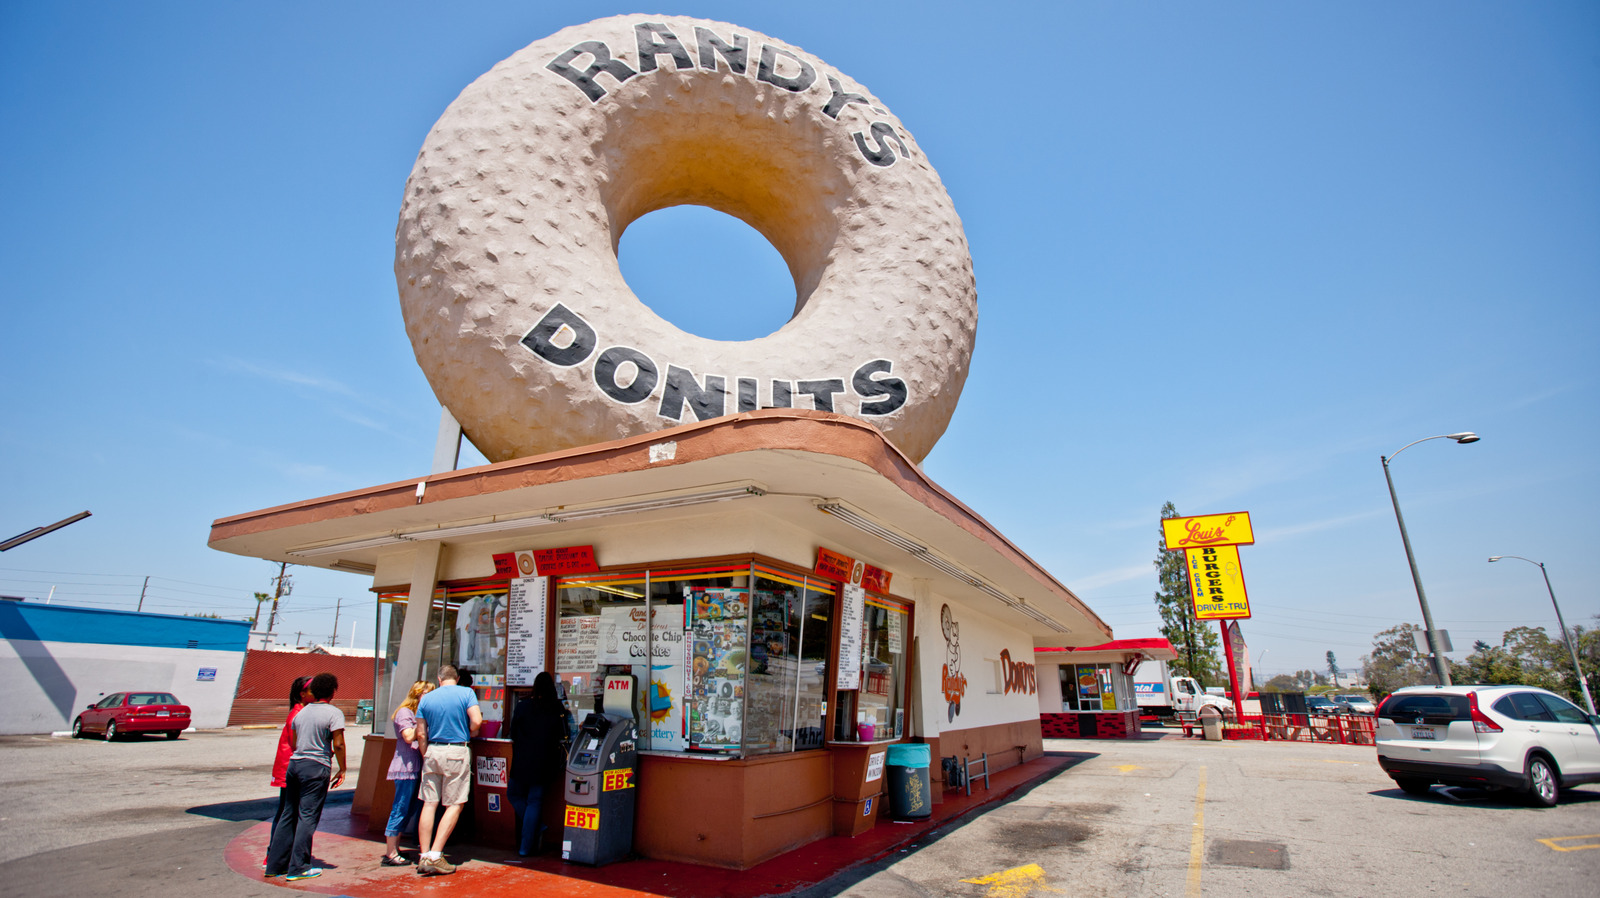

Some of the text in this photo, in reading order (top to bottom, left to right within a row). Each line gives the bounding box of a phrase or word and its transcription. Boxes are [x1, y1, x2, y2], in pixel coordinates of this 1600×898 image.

[545, 22, 911, 168] RANDY'S
[518, 301, 908, 422] DONUTS
[1202, 548, 1224, 602] BURGERS
[1194, 573, 1204, 597] CREAM
[1197, 602, 1247, 612] DRIVE-TRU
[622, 631, 682, 643] Chocote Chip
[608, 680, 629, 690] ATM
[1135, 684, 1154, 692] ntal
[479, 772, 506, 783] WINDO
[605, 772, 634, 791] EBT
[567, 811, 596, 828] EBT
